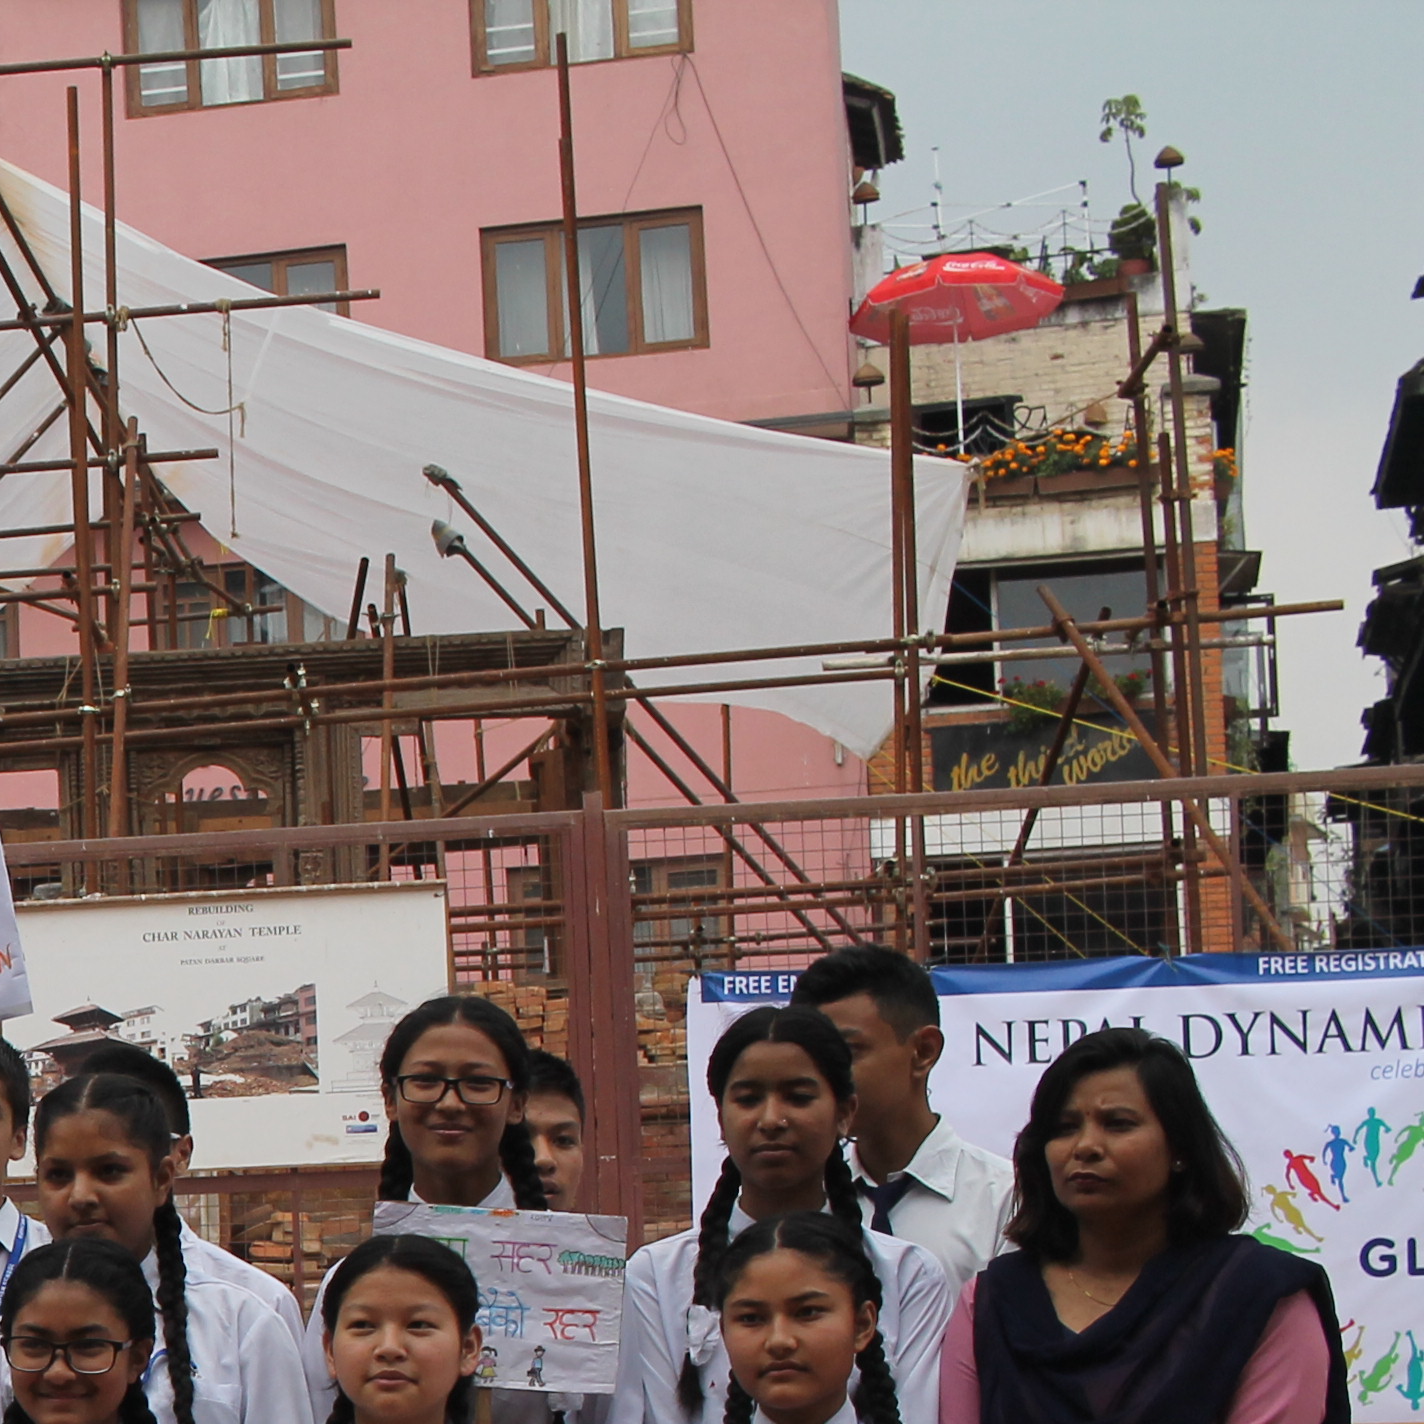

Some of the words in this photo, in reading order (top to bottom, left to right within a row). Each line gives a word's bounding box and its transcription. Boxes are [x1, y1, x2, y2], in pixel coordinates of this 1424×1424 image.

[951, 753, 999, 792] the
[188, 904, 254, 915] REBUILDING
[142, 932, 179, 943] CHAR
[183, 927, 243, 940] NARAYAN
[249, 925, 302, 937] TEMPLE
[1258, 954, 1309, 976] FREE
[723, 974, 772, 995] FREE
